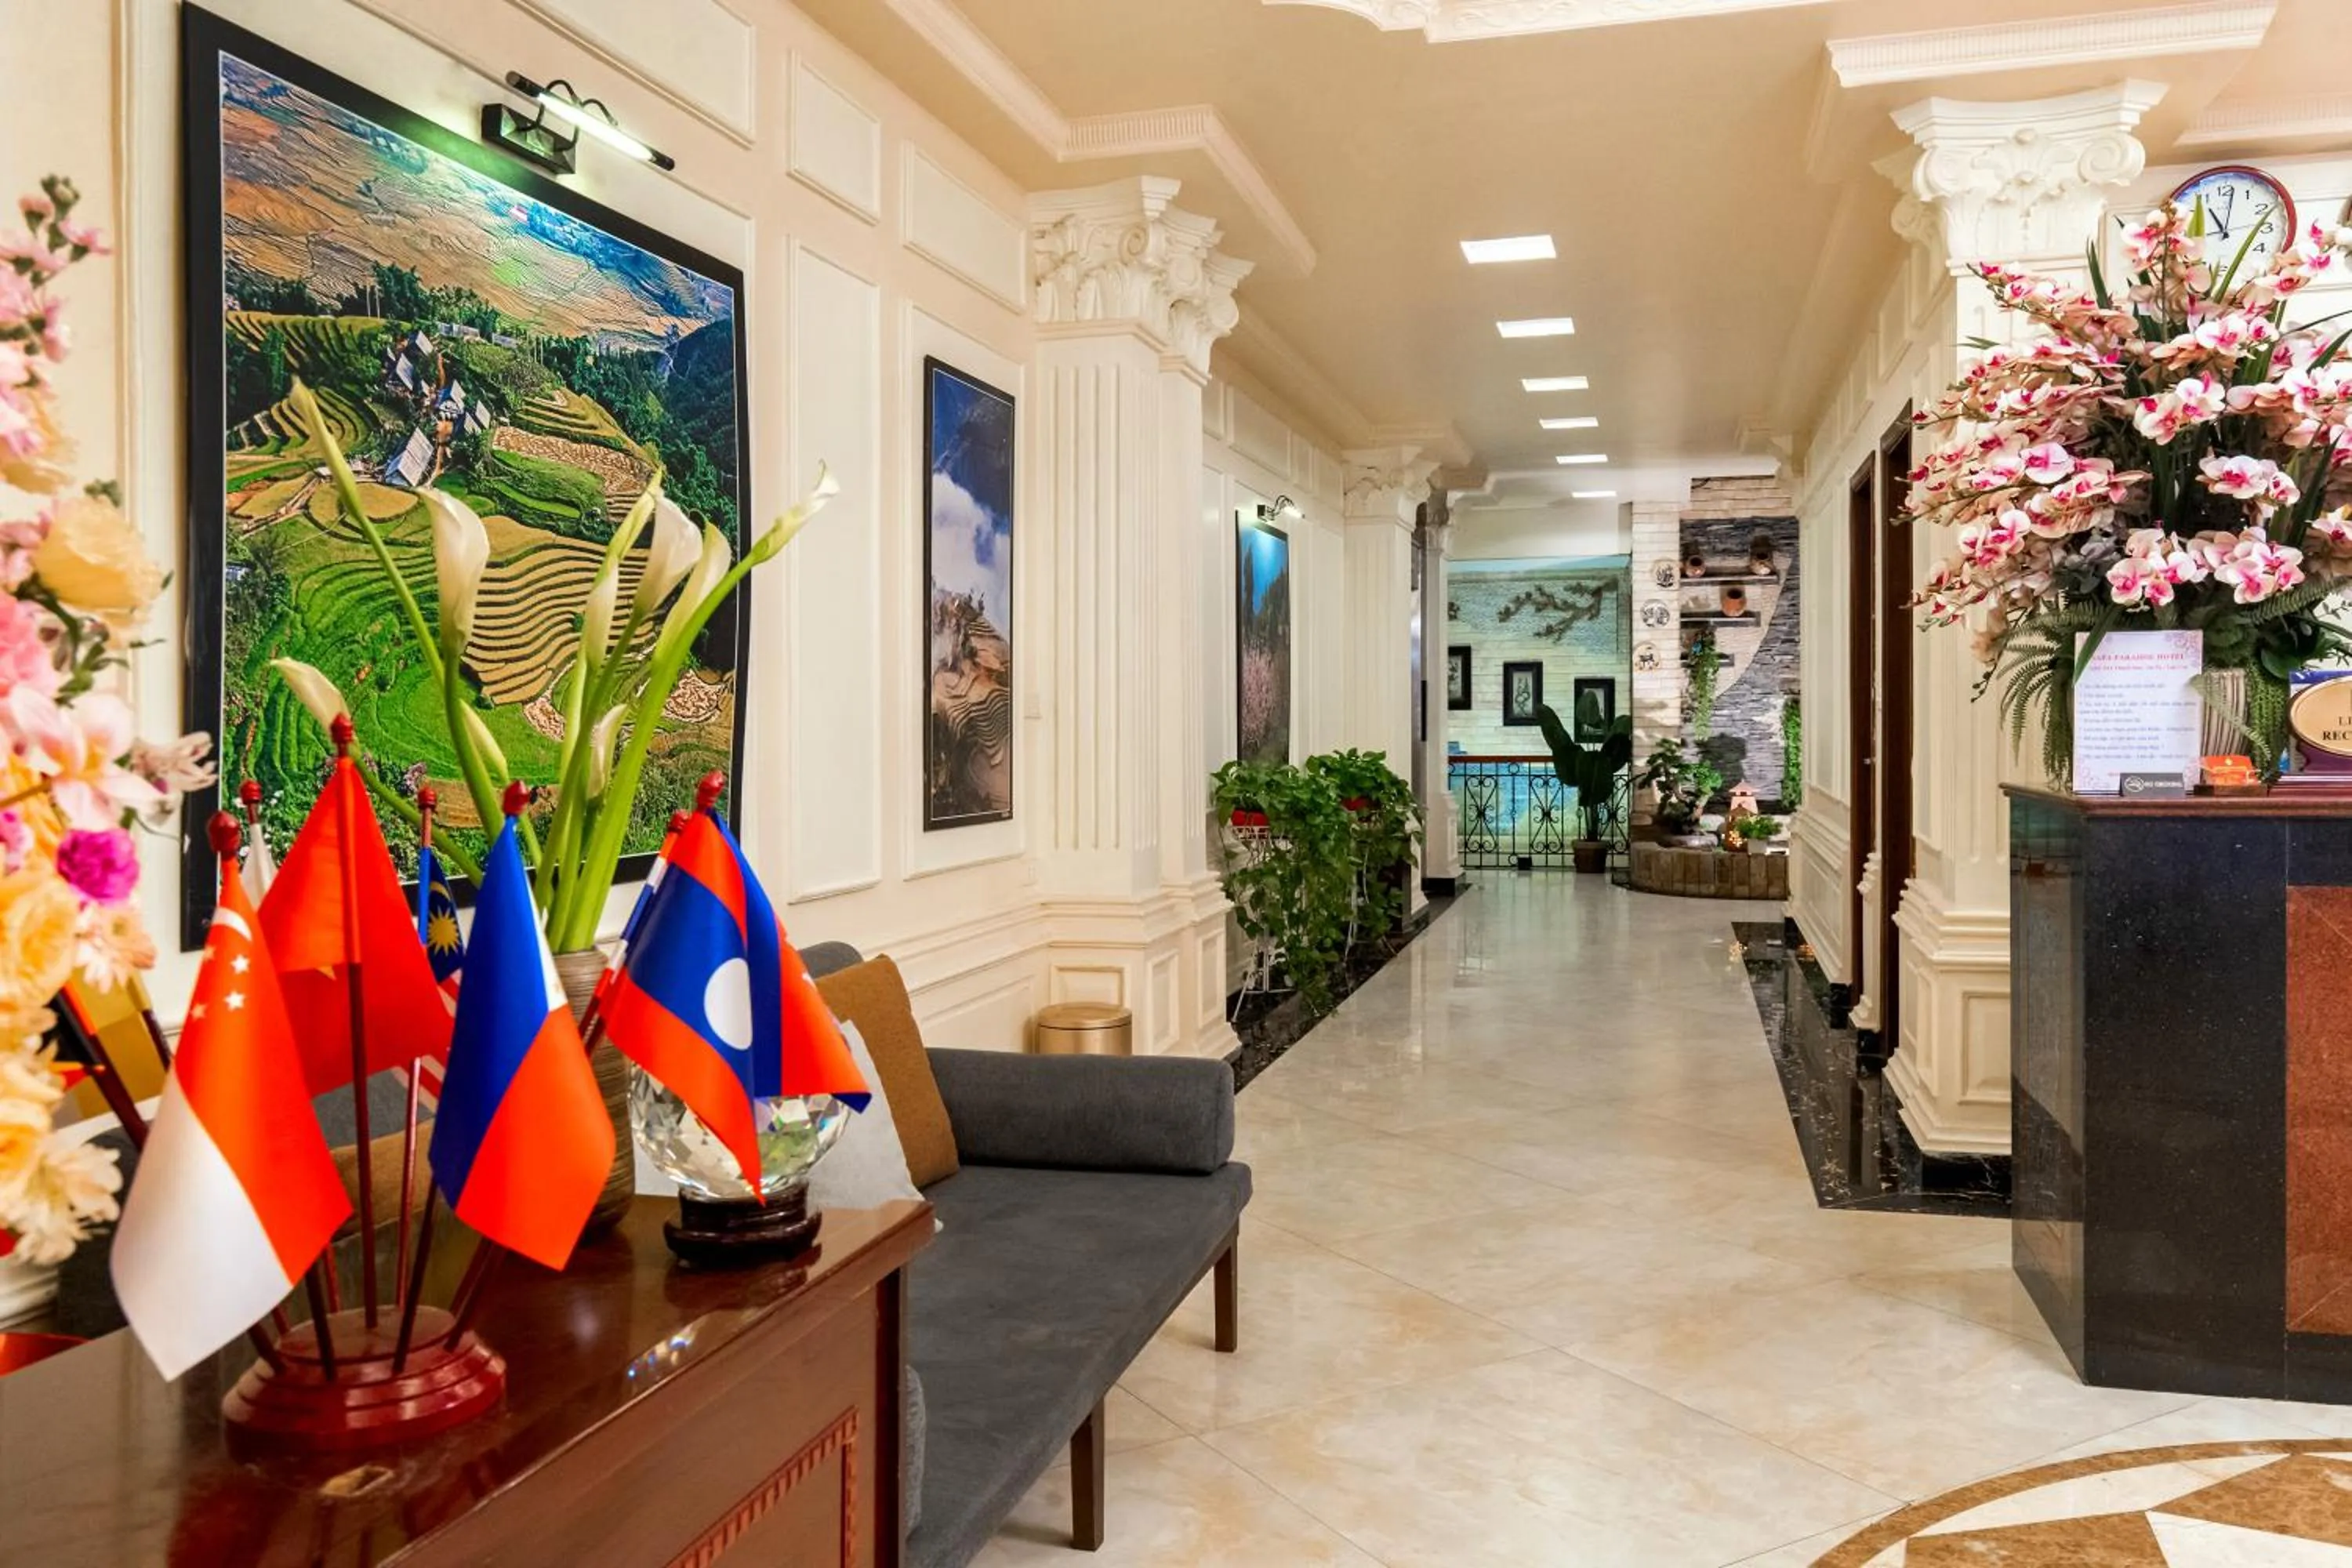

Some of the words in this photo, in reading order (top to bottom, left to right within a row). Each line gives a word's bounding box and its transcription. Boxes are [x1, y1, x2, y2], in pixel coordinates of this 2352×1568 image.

[2217, 184, 2234, 197] 12
[2245, 190, 2250, 200] 1
[2260, 222, 2273, 234] 3
[2252, 243, 2266, 253] 4
